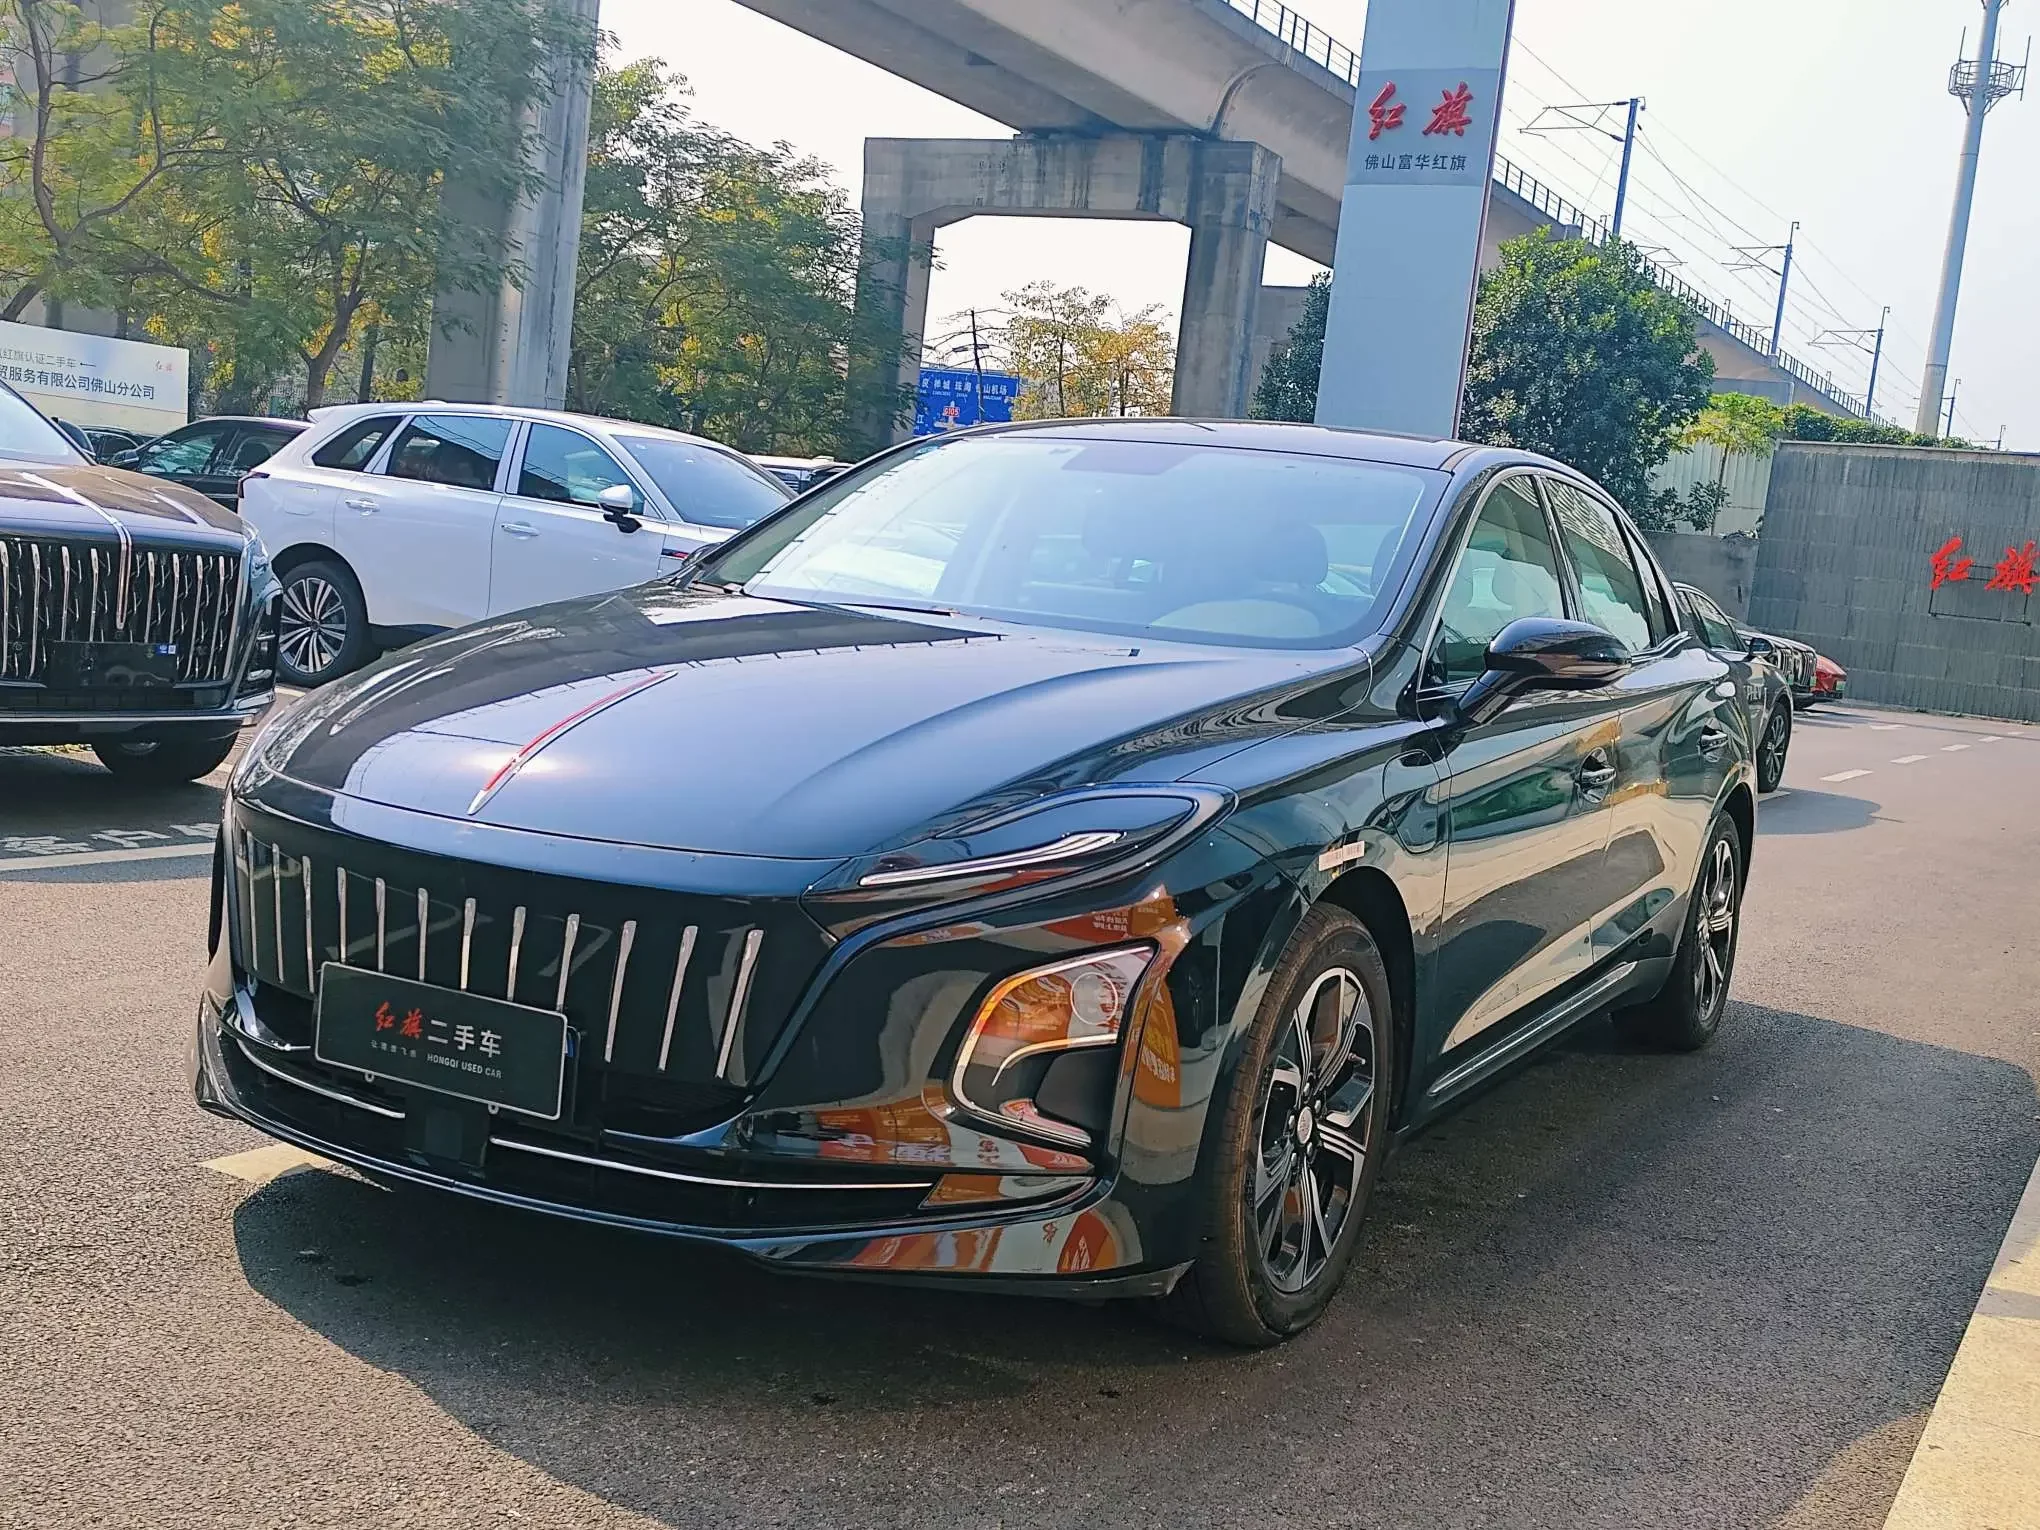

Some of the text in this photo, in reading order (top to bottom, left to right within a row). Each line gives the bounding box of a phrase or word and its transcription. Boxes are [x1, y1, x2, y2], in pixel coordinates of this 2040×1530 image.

[1368, 80, 1474, 141] 红旗
[1364, 153, 1468, 171] 佛山富华红旗
[0, 347, 77, 369] 红旗认证二手车
[944, 407, 959, 416] G105
[1930, 536, 2040, 595] 红旗
[427, 1053, 502, 1079] HONGQI USED CAR
